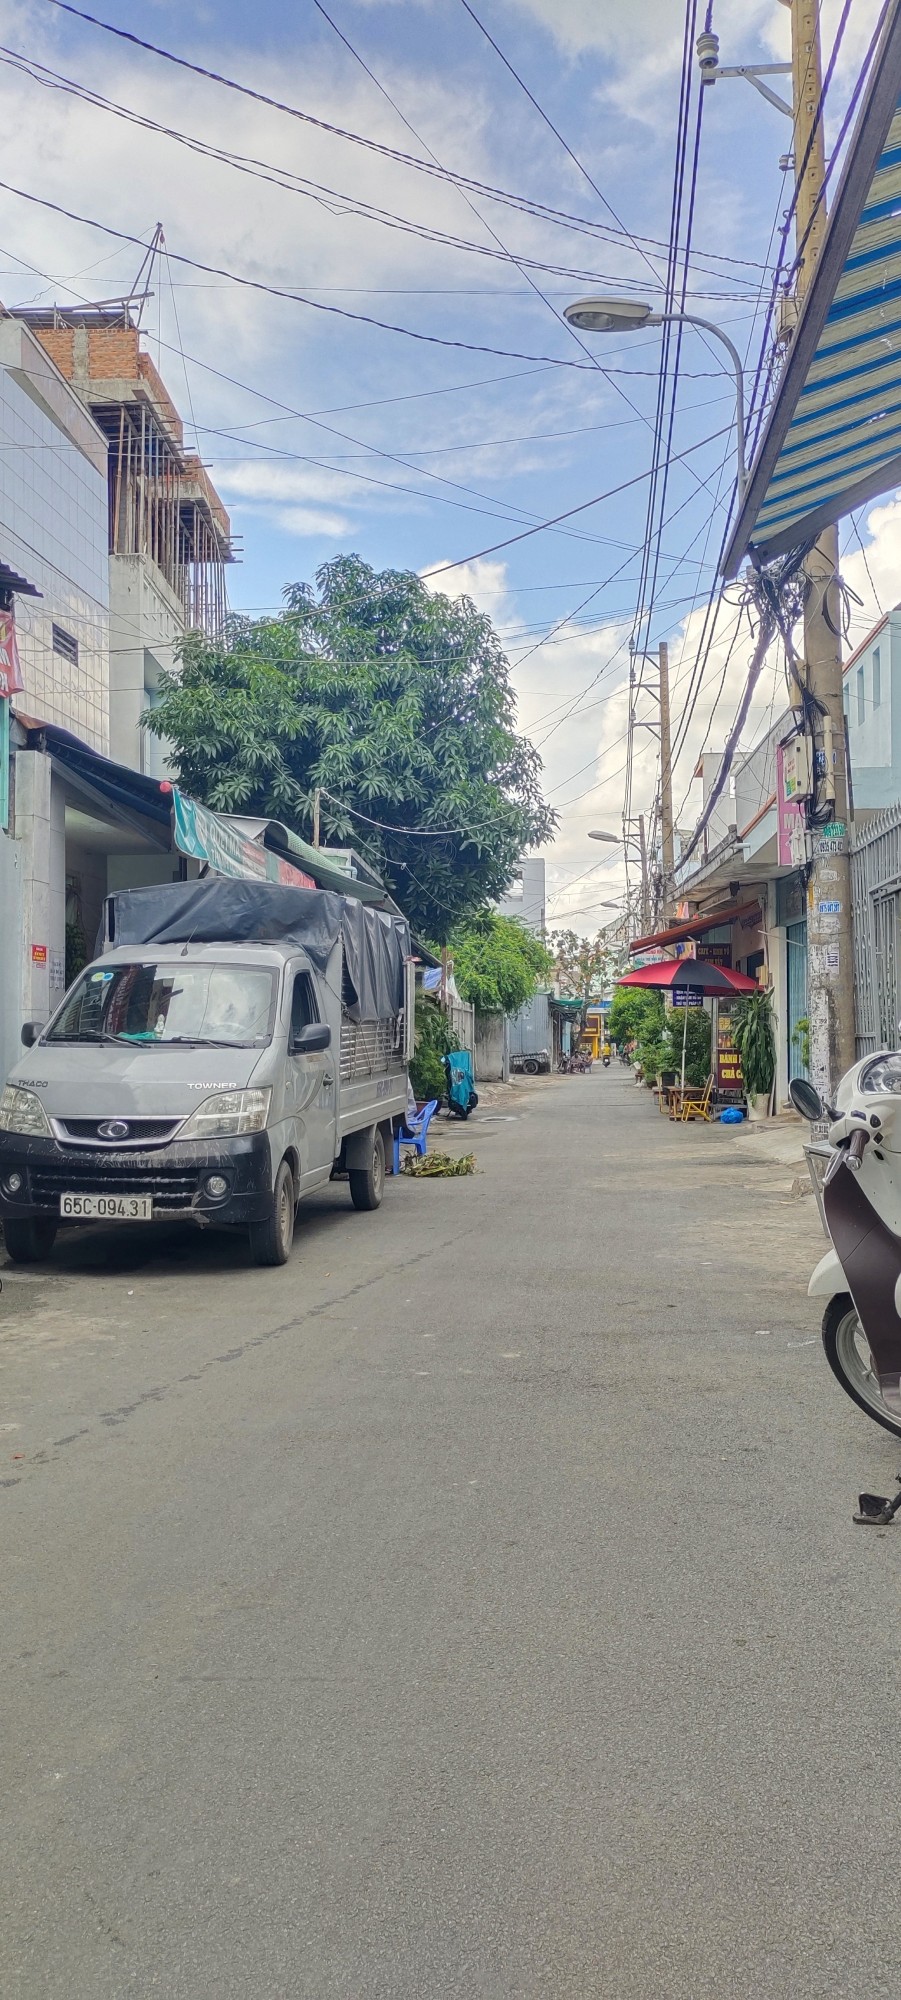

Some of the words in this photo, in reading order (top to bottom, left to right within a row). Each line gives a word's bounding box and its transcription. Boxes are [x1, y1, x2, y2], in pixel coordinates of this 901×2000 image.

[18, 1079, 48, 1088] THACO
[187, 1082, 237, 1090] TOWNER
[63, 1197, 147, 1218] 65C-094.31
